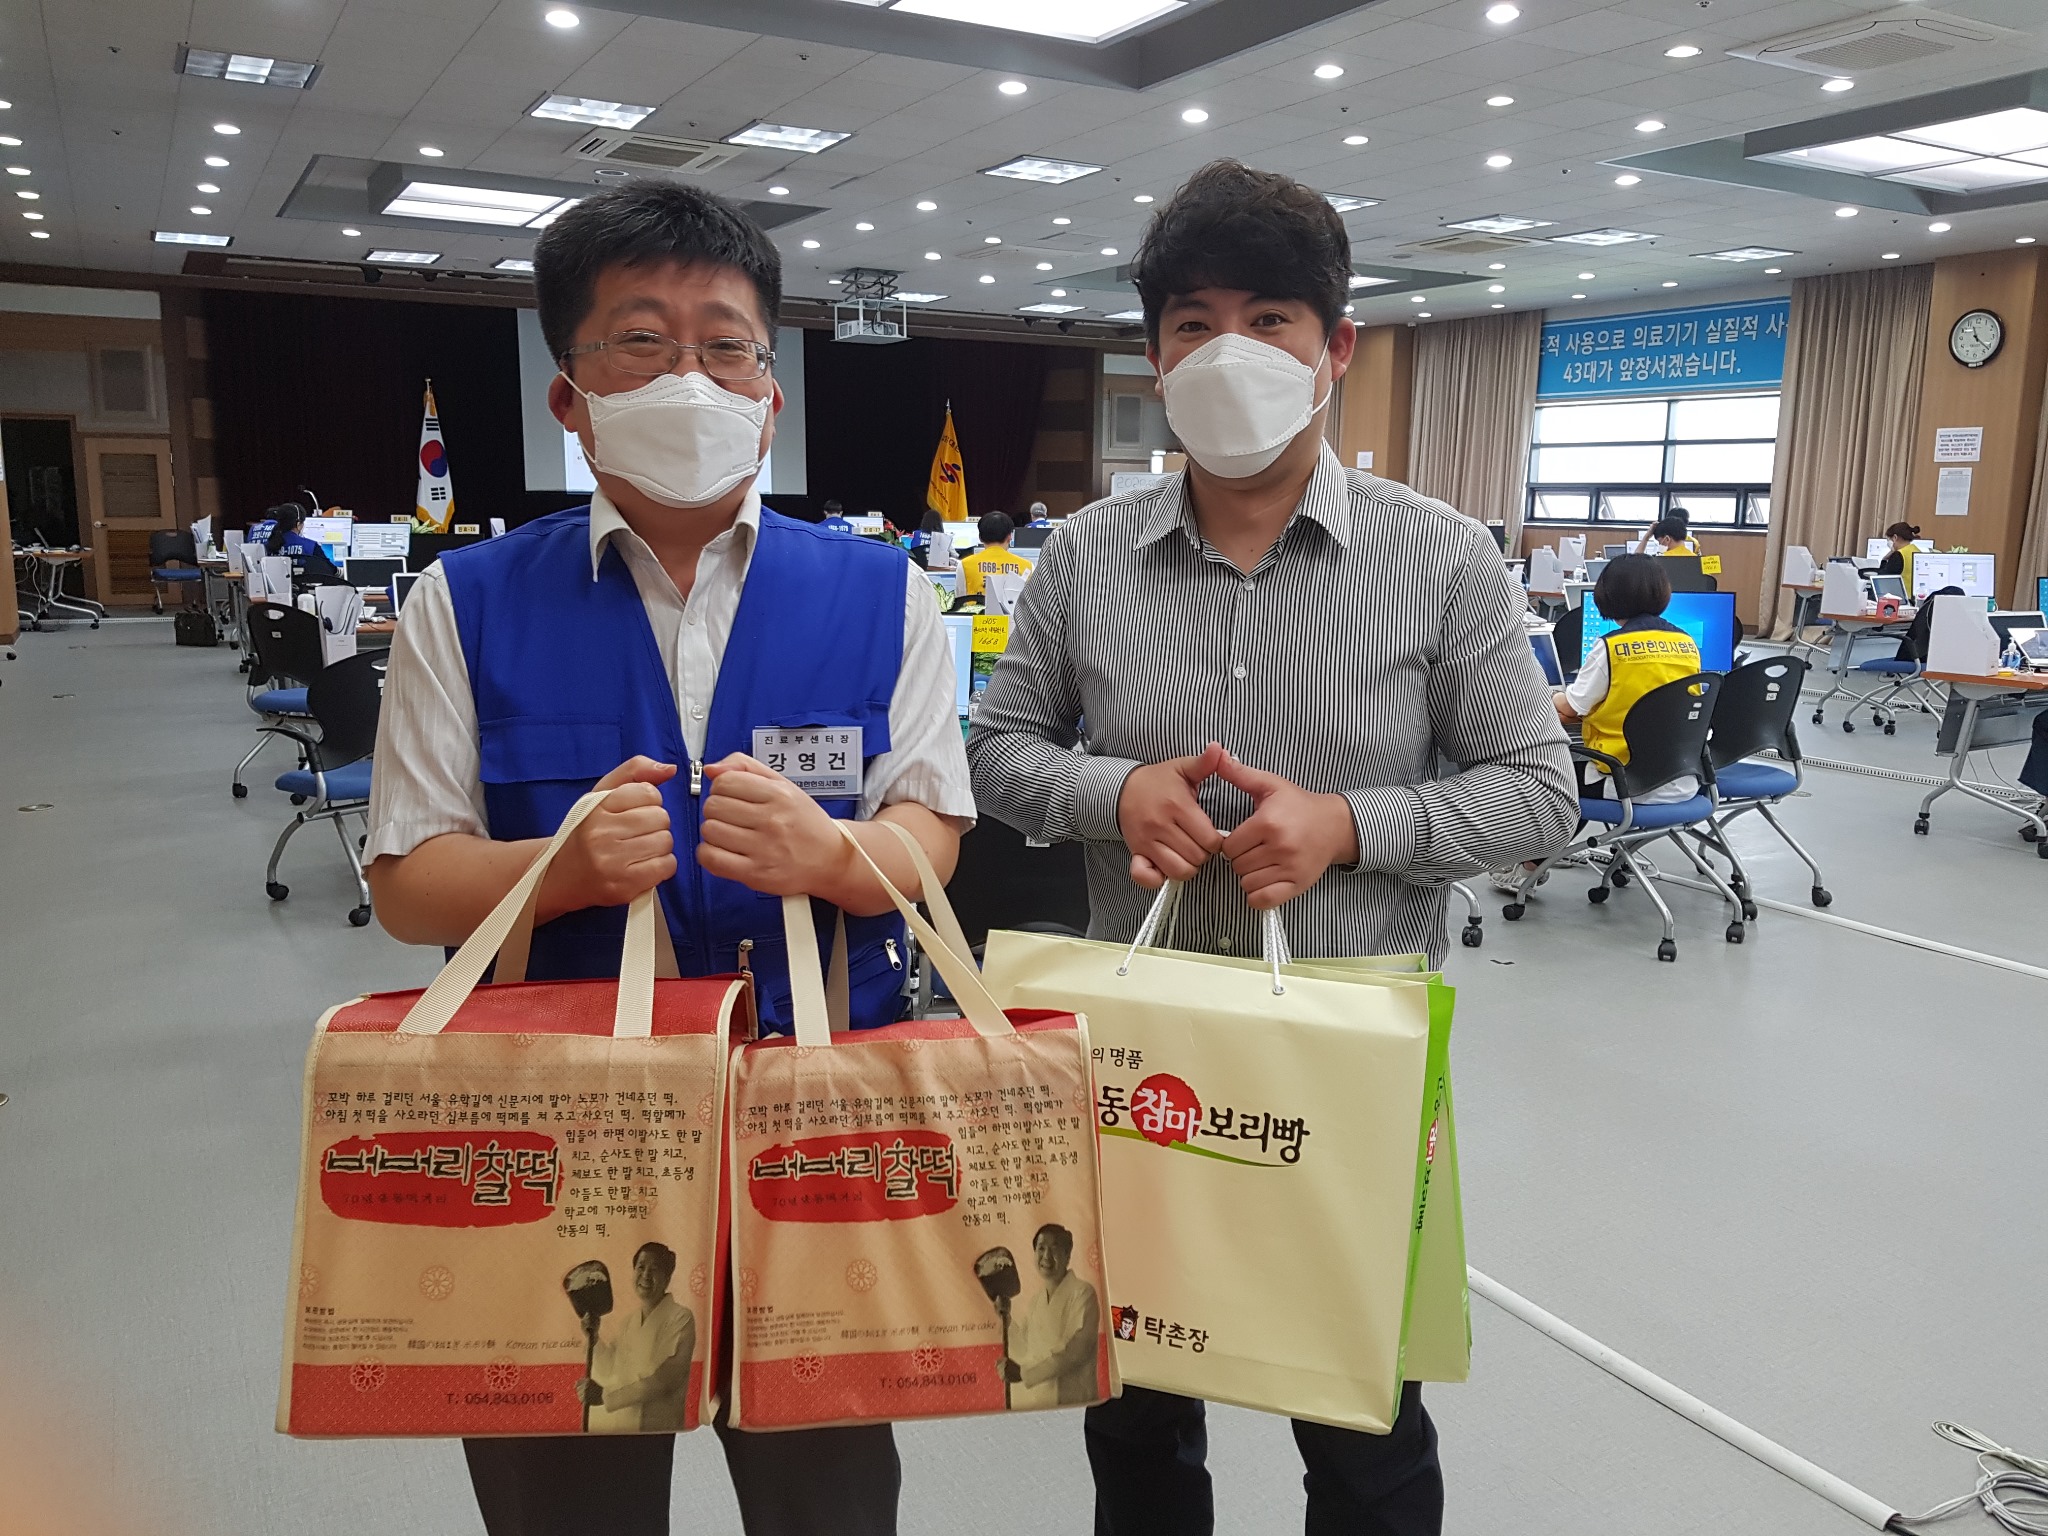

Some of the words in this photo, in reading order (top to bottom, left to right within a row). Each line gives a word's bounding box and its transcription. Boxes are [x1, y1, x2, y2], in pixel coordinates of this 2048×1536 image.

[1566, 330, 1625, 355] 사용으로
[1634, 321, 1699, 350] 의료기기
[1706, 314, 1759, 344] 실질적
[1765, 312, 1789, 339] 사
[1563, 359, 1613, 383] 43대가
[1619, 350, 1742, 382] 앞장서겠습니다.
[977, 562, 1019, 575] 1668-1075
[1615, 641, 1697, 656] 대한한의사협회
[1109, 1047, 1144, 1070] 명품
[356, 1092, 376, 1104] 하루
[382, 1092, 414, 1106] 걸리던
[420, 1093, 442, 1107] 서울
[448, 1093, 493, 1108] 유학길에
[497, 1094, 543, 1109] 신문지에
[550, 1094, 571, 1108] 말아
[577, 1092, 609, 1104] 노모가
[615, 1092, 657, 1106] 건네주던
[773, 1102, 792, 1114] 하루
[796, 1099, 824, 1114] 걸리던
[829, 1098, 849, 1111] 서울
[853, 1096, 893, 1111] 유학길에
[899, 1095, 936, 1110] 신문지에
[940, 1095, 958, 1108] 말아
[964, 1091, 992, 1103] 노모가
[998, 1085, 1035, 1101] 건네주던
[325, 1109, 347, 1123] 아침
[394, 1109, 440, 1125] 사오라던
[446, 1110, 491, 1126] 심부름에
[496, 1111, 531, 1126] 떡메를
[553, 1110, 577, 1123] 주고
[582, 1109, 614, 1123] 사오던
[748, 1121, 767, 1134] 아침
[809, 1113, 850, 1127] 사오라던
[854, 1112, 894, 1127] 심부름에
[899, 1111, 926, 1126] 떡메를
[947, 1109, 965, 1120] 주고
[970, 1105, 999, 1119] 사오던
[661, 1166, 695, 1181] 초등생
[570, 1186, 603, 1201] 아들도
[639, 1186, 659, 1197] 치고
[967, 1194, 998, 1210] 학교에
[564, 1205, 598, 1220] 학교에
[604, 1205, 648, 1219] 가야했던
[962, 1213, 991, 1227] 안동의
[556, 1224, 588, 1238] 안동의
[928, 1324, 958, 1336] Korean
[961, 1322, 977, 1333] rice
[978, 1320, 997, 1332] cake
[1144, 1316, 1209, 1353] 탁촌장
[505, 1339, 538, 1350] Korean
[541, 1340, 558, 1350] rice
[559, 1338, 582, 1350] cake
